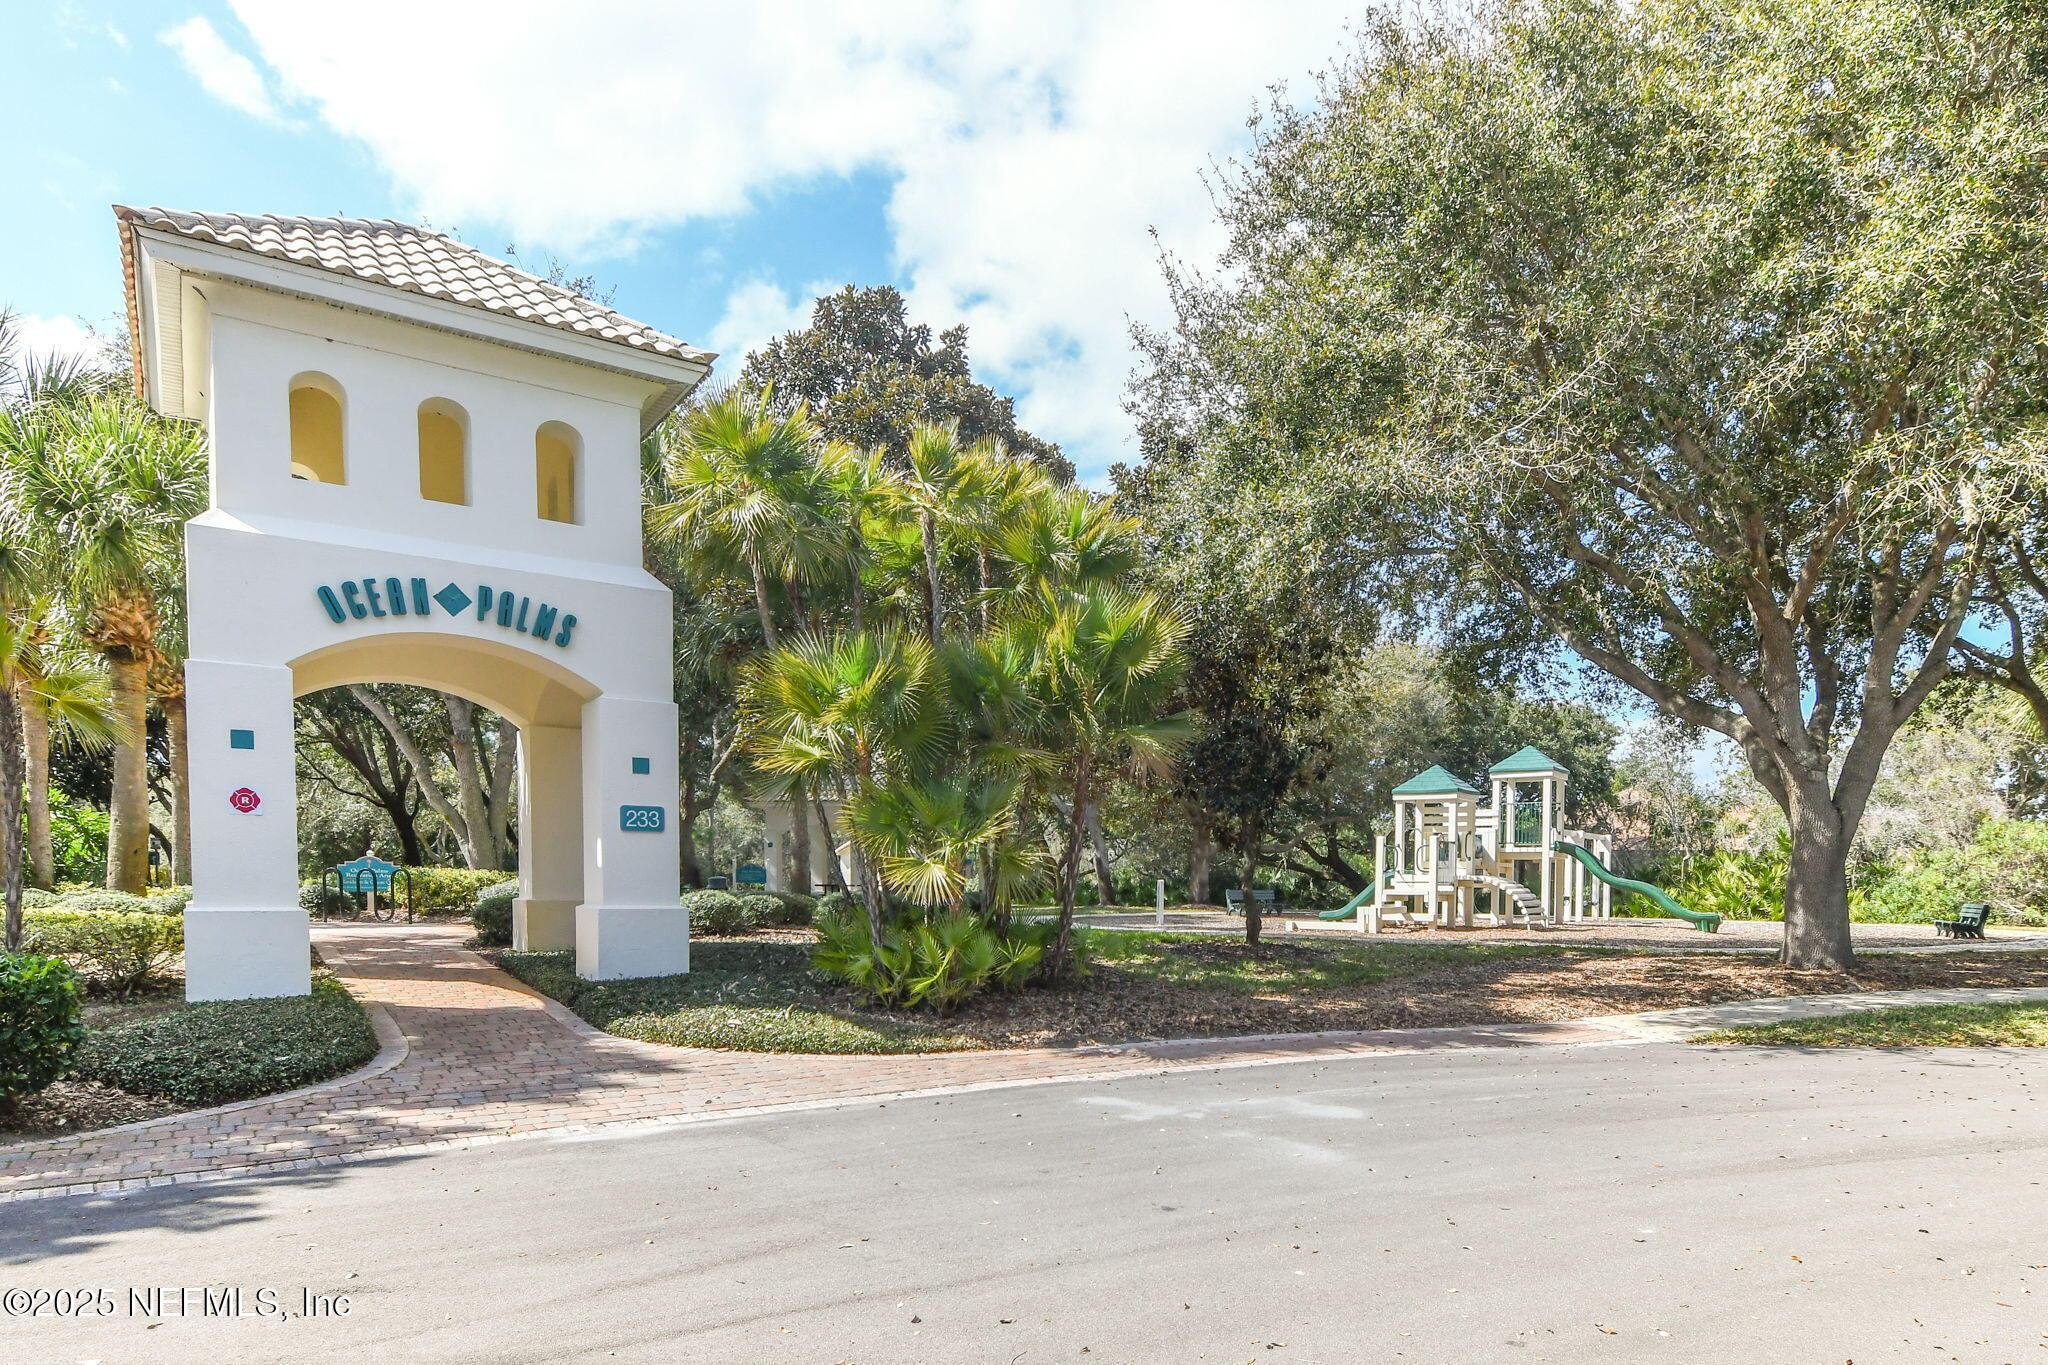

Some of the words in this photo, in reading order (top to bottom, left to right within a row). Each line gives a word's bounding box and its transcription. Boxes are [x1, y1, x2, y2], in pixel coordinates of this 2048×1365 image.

[318, 577, 430, 624] OCEAN
[476, 585, 577, 647] PALMS
[241, 796, 250, 804] R
[626, 810, 660, 828] 233
